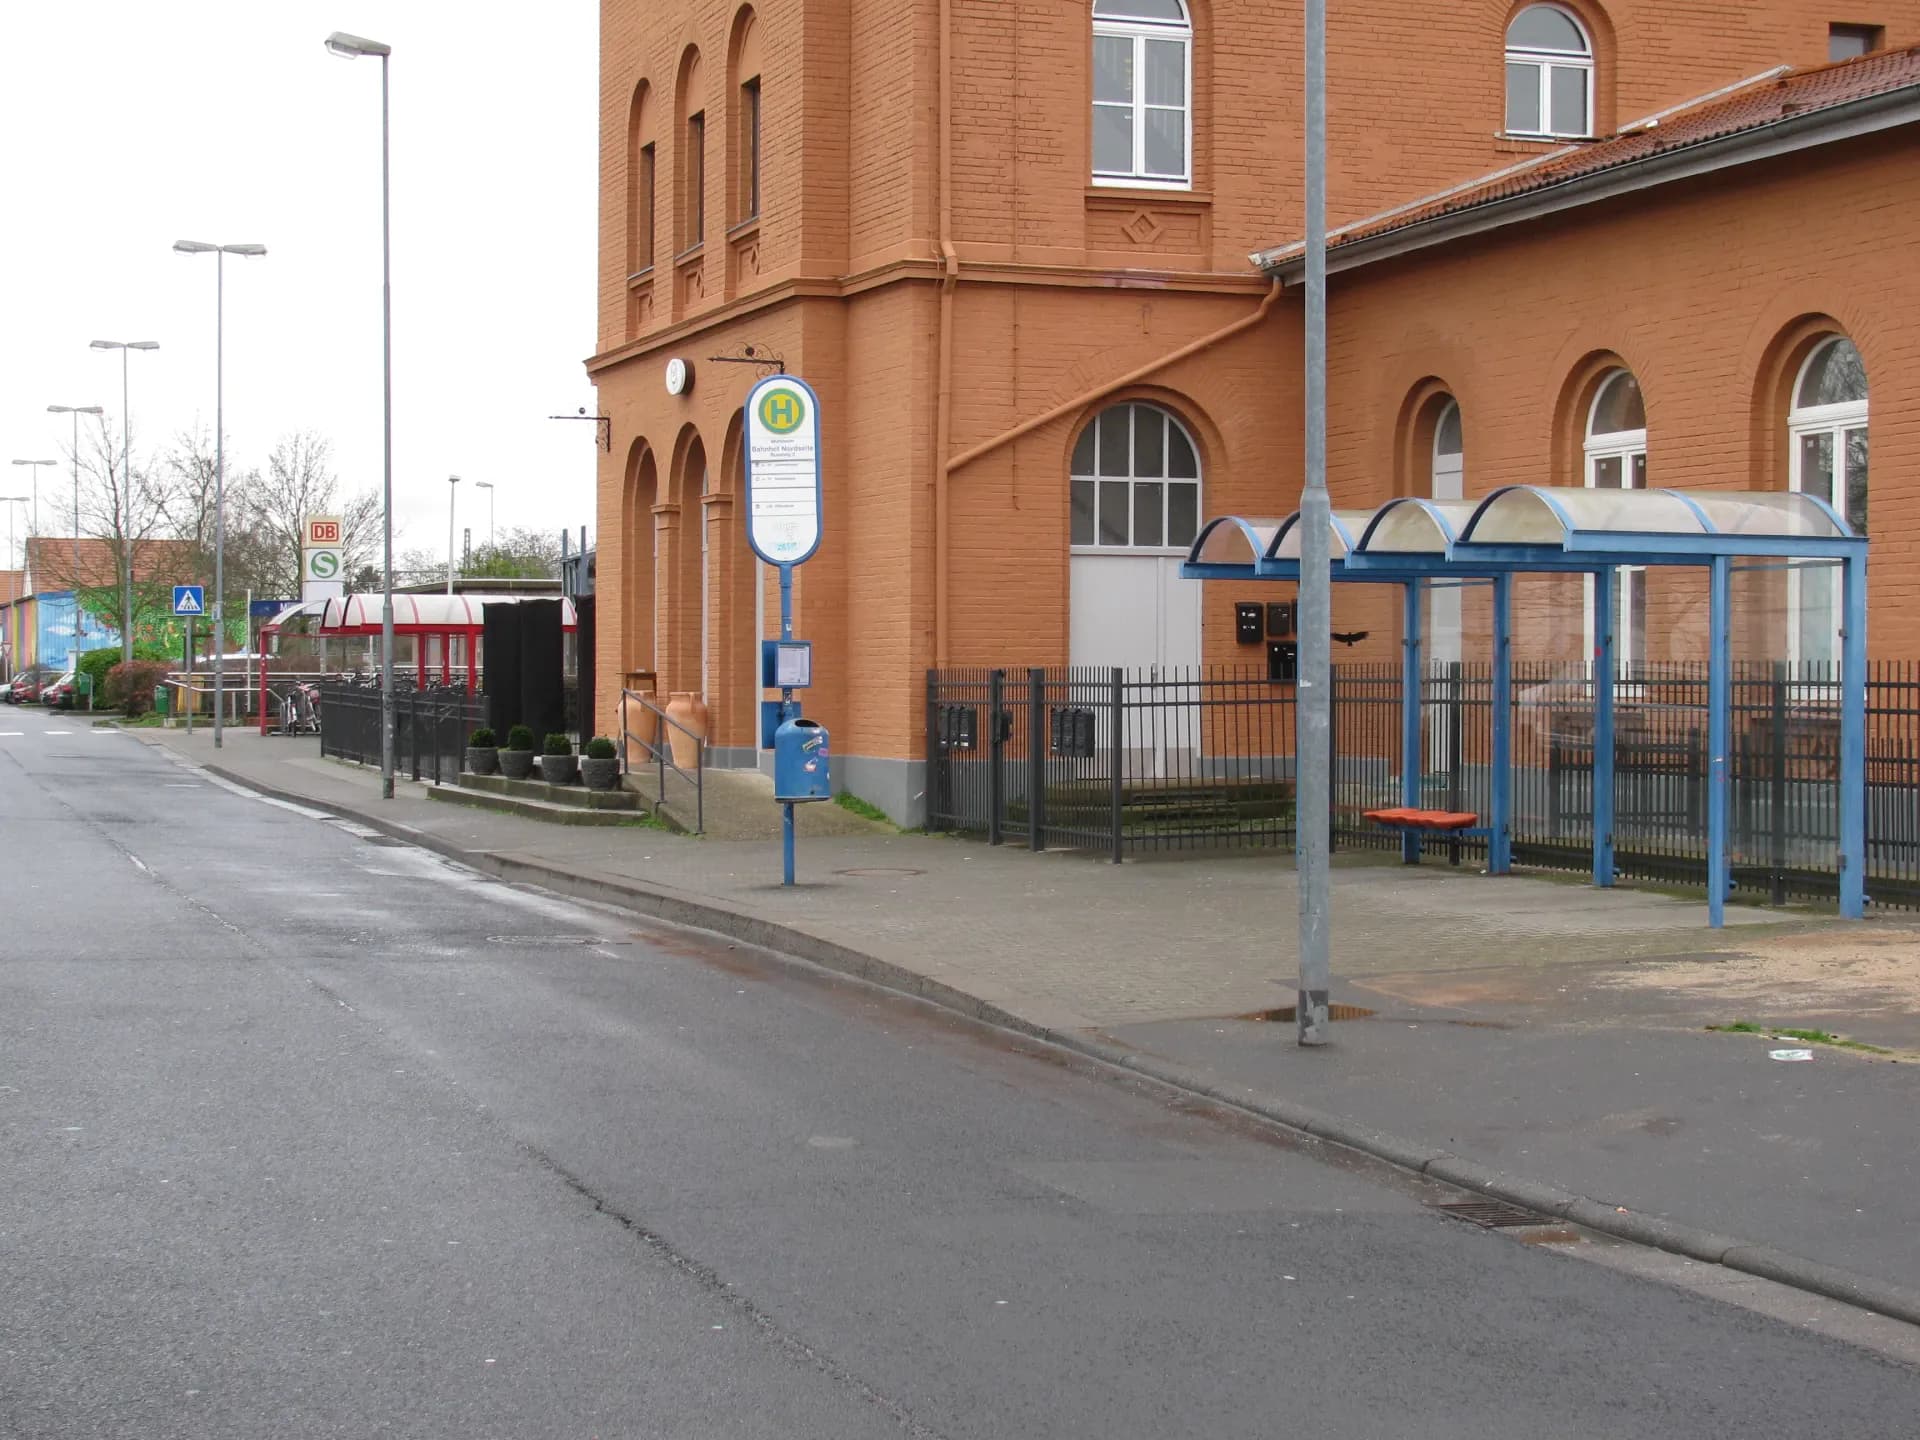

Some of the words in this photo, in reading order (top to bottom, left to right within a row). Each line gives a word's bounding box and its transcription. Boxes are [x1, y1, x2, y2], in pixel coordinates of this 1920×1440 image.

[771, 399, 793, 424] H
[314, 525, 336, 539] DB
[314, 551, 335, 578] S
